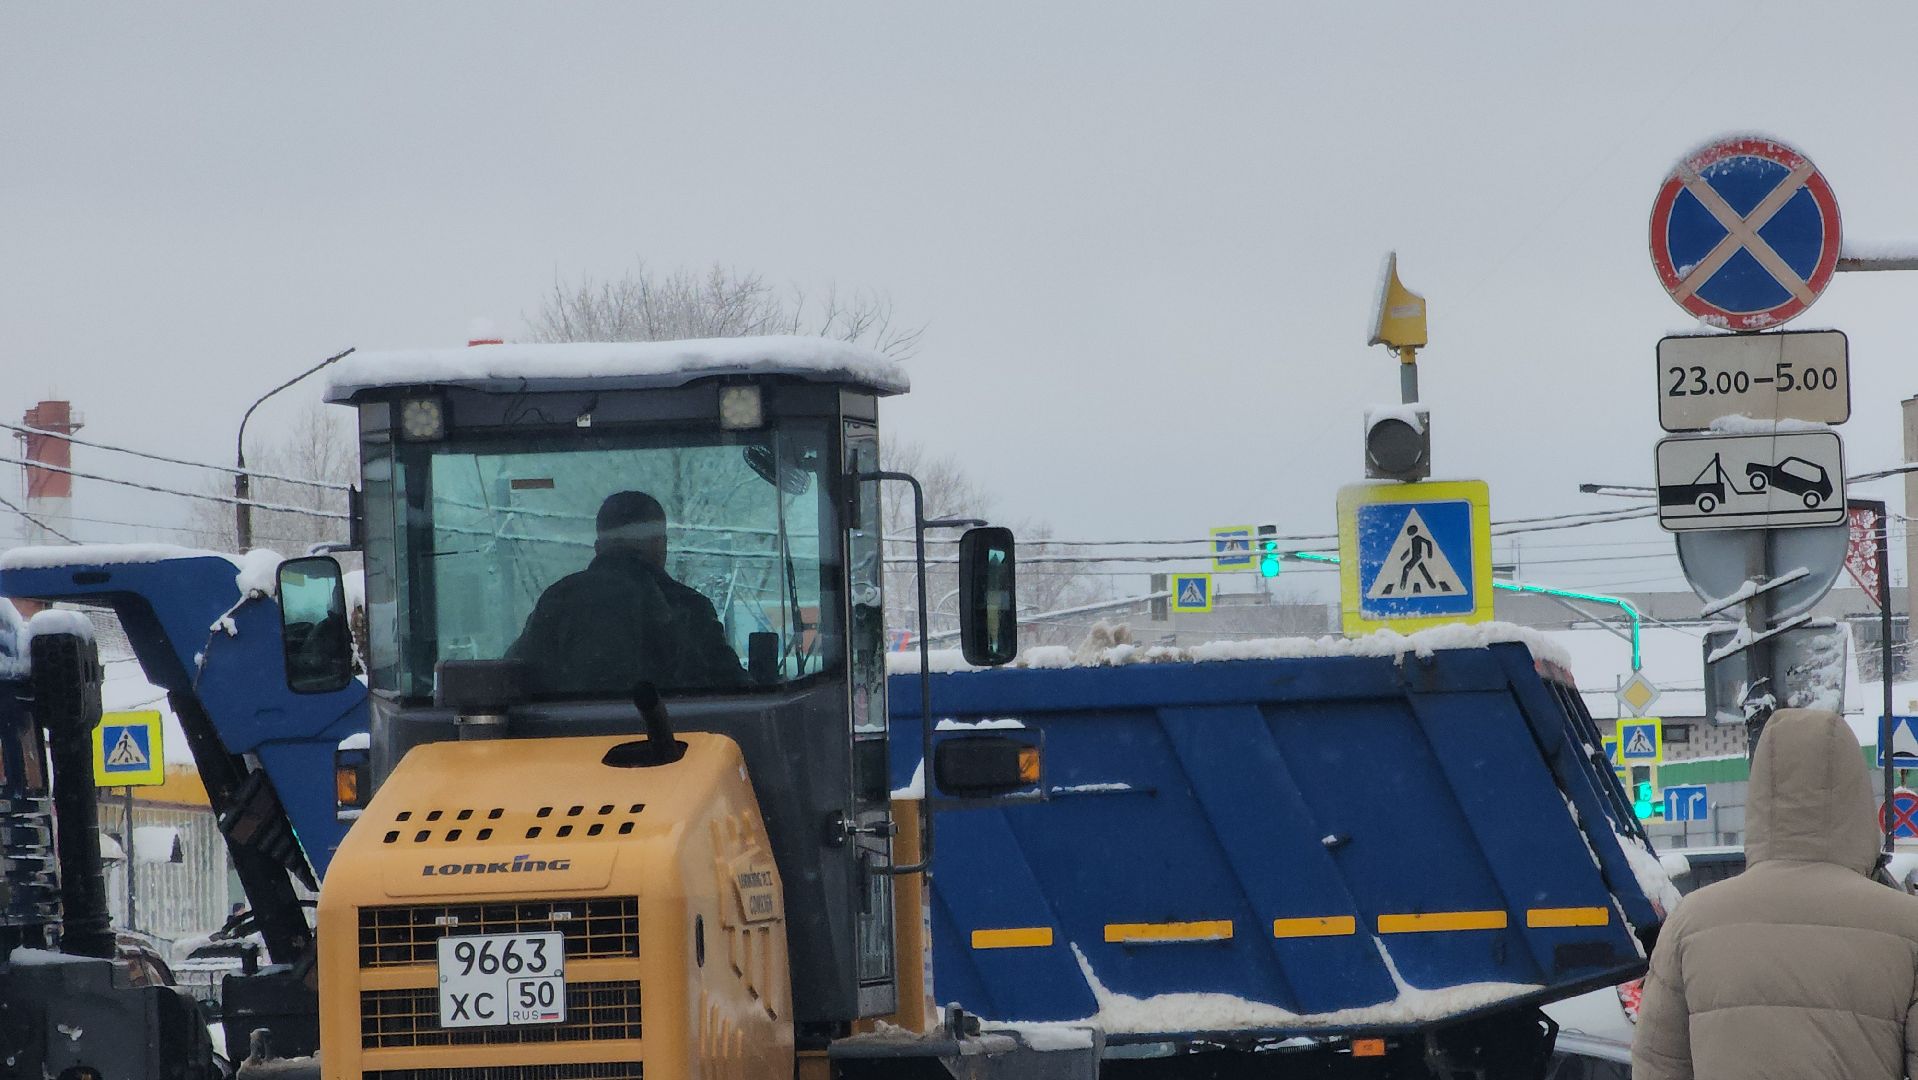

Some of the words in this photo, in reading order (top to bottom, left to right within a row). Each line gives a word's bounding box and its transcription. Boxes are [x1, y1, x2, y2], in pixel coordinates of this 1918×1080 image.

[422, 854, 571, 876] LONKING
[454, 939, 547, 976] 9663
[519, 981, 555, 1009] 50
[512, 1010, 539, 1020] RUS
